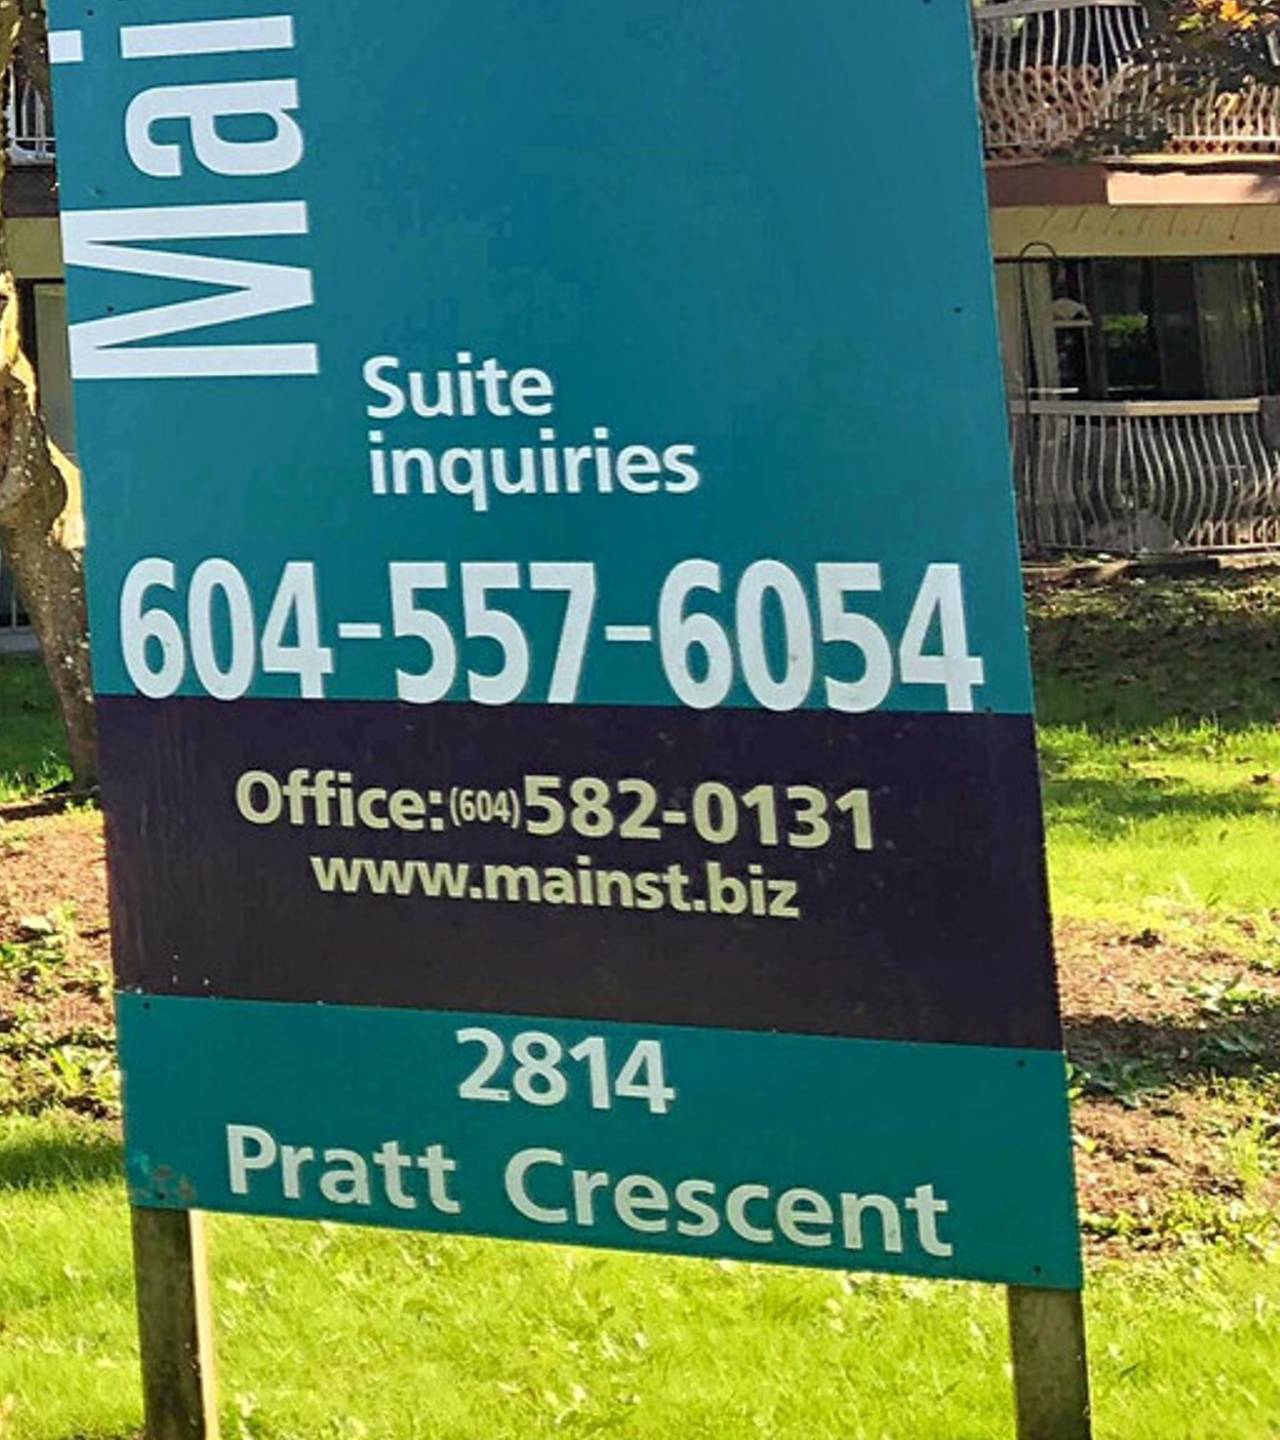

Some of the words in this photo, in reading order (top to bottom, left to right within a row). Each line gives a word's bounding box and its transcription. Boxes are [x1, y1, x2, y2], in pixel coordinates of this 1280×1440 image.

[364, 353, 555, 421] Suite
[369, 426, 700, 511] inquiries
[119, 557, 985, 714] 604-557-6054
[312, 853, 801, 918] www.mainst.biz
[455, 1026, 676, 1114] 2814
[225, 1123, 461, 1215] Pratt
[504, 1147, 954, 1259] Crescent
